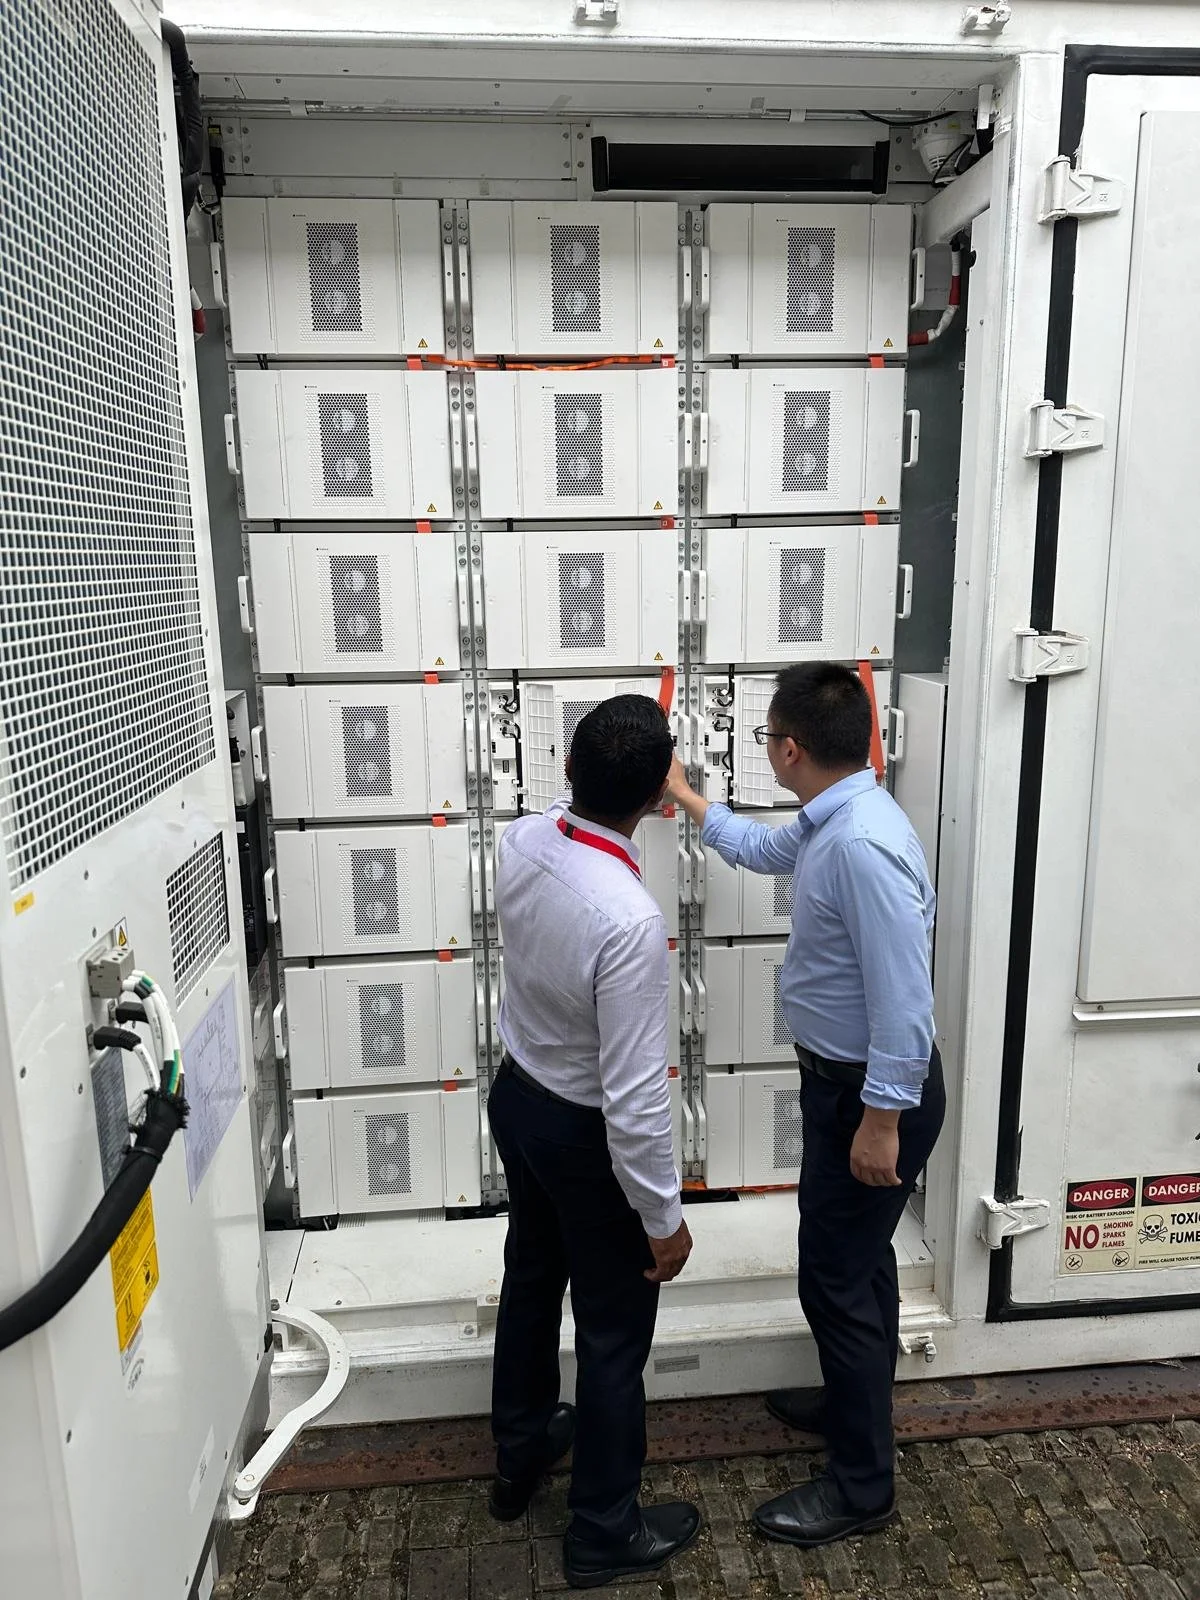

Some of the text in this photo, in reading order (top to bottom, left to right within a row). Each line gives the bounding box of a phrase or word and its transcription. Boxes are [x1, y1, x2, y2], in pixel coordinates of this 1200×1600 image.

[1073, 1188, 1130, 1202] DANGER
[1171, 1211, 1200, 1225] TOXI
[1103, 1221, 1134, 1229] SMOKING
[1064, 1224, 1100, 1250] NO
[1102, 1231, 1126, 1239] SPARKS
[1101, 1240, 1125, 1248] FLAMES
